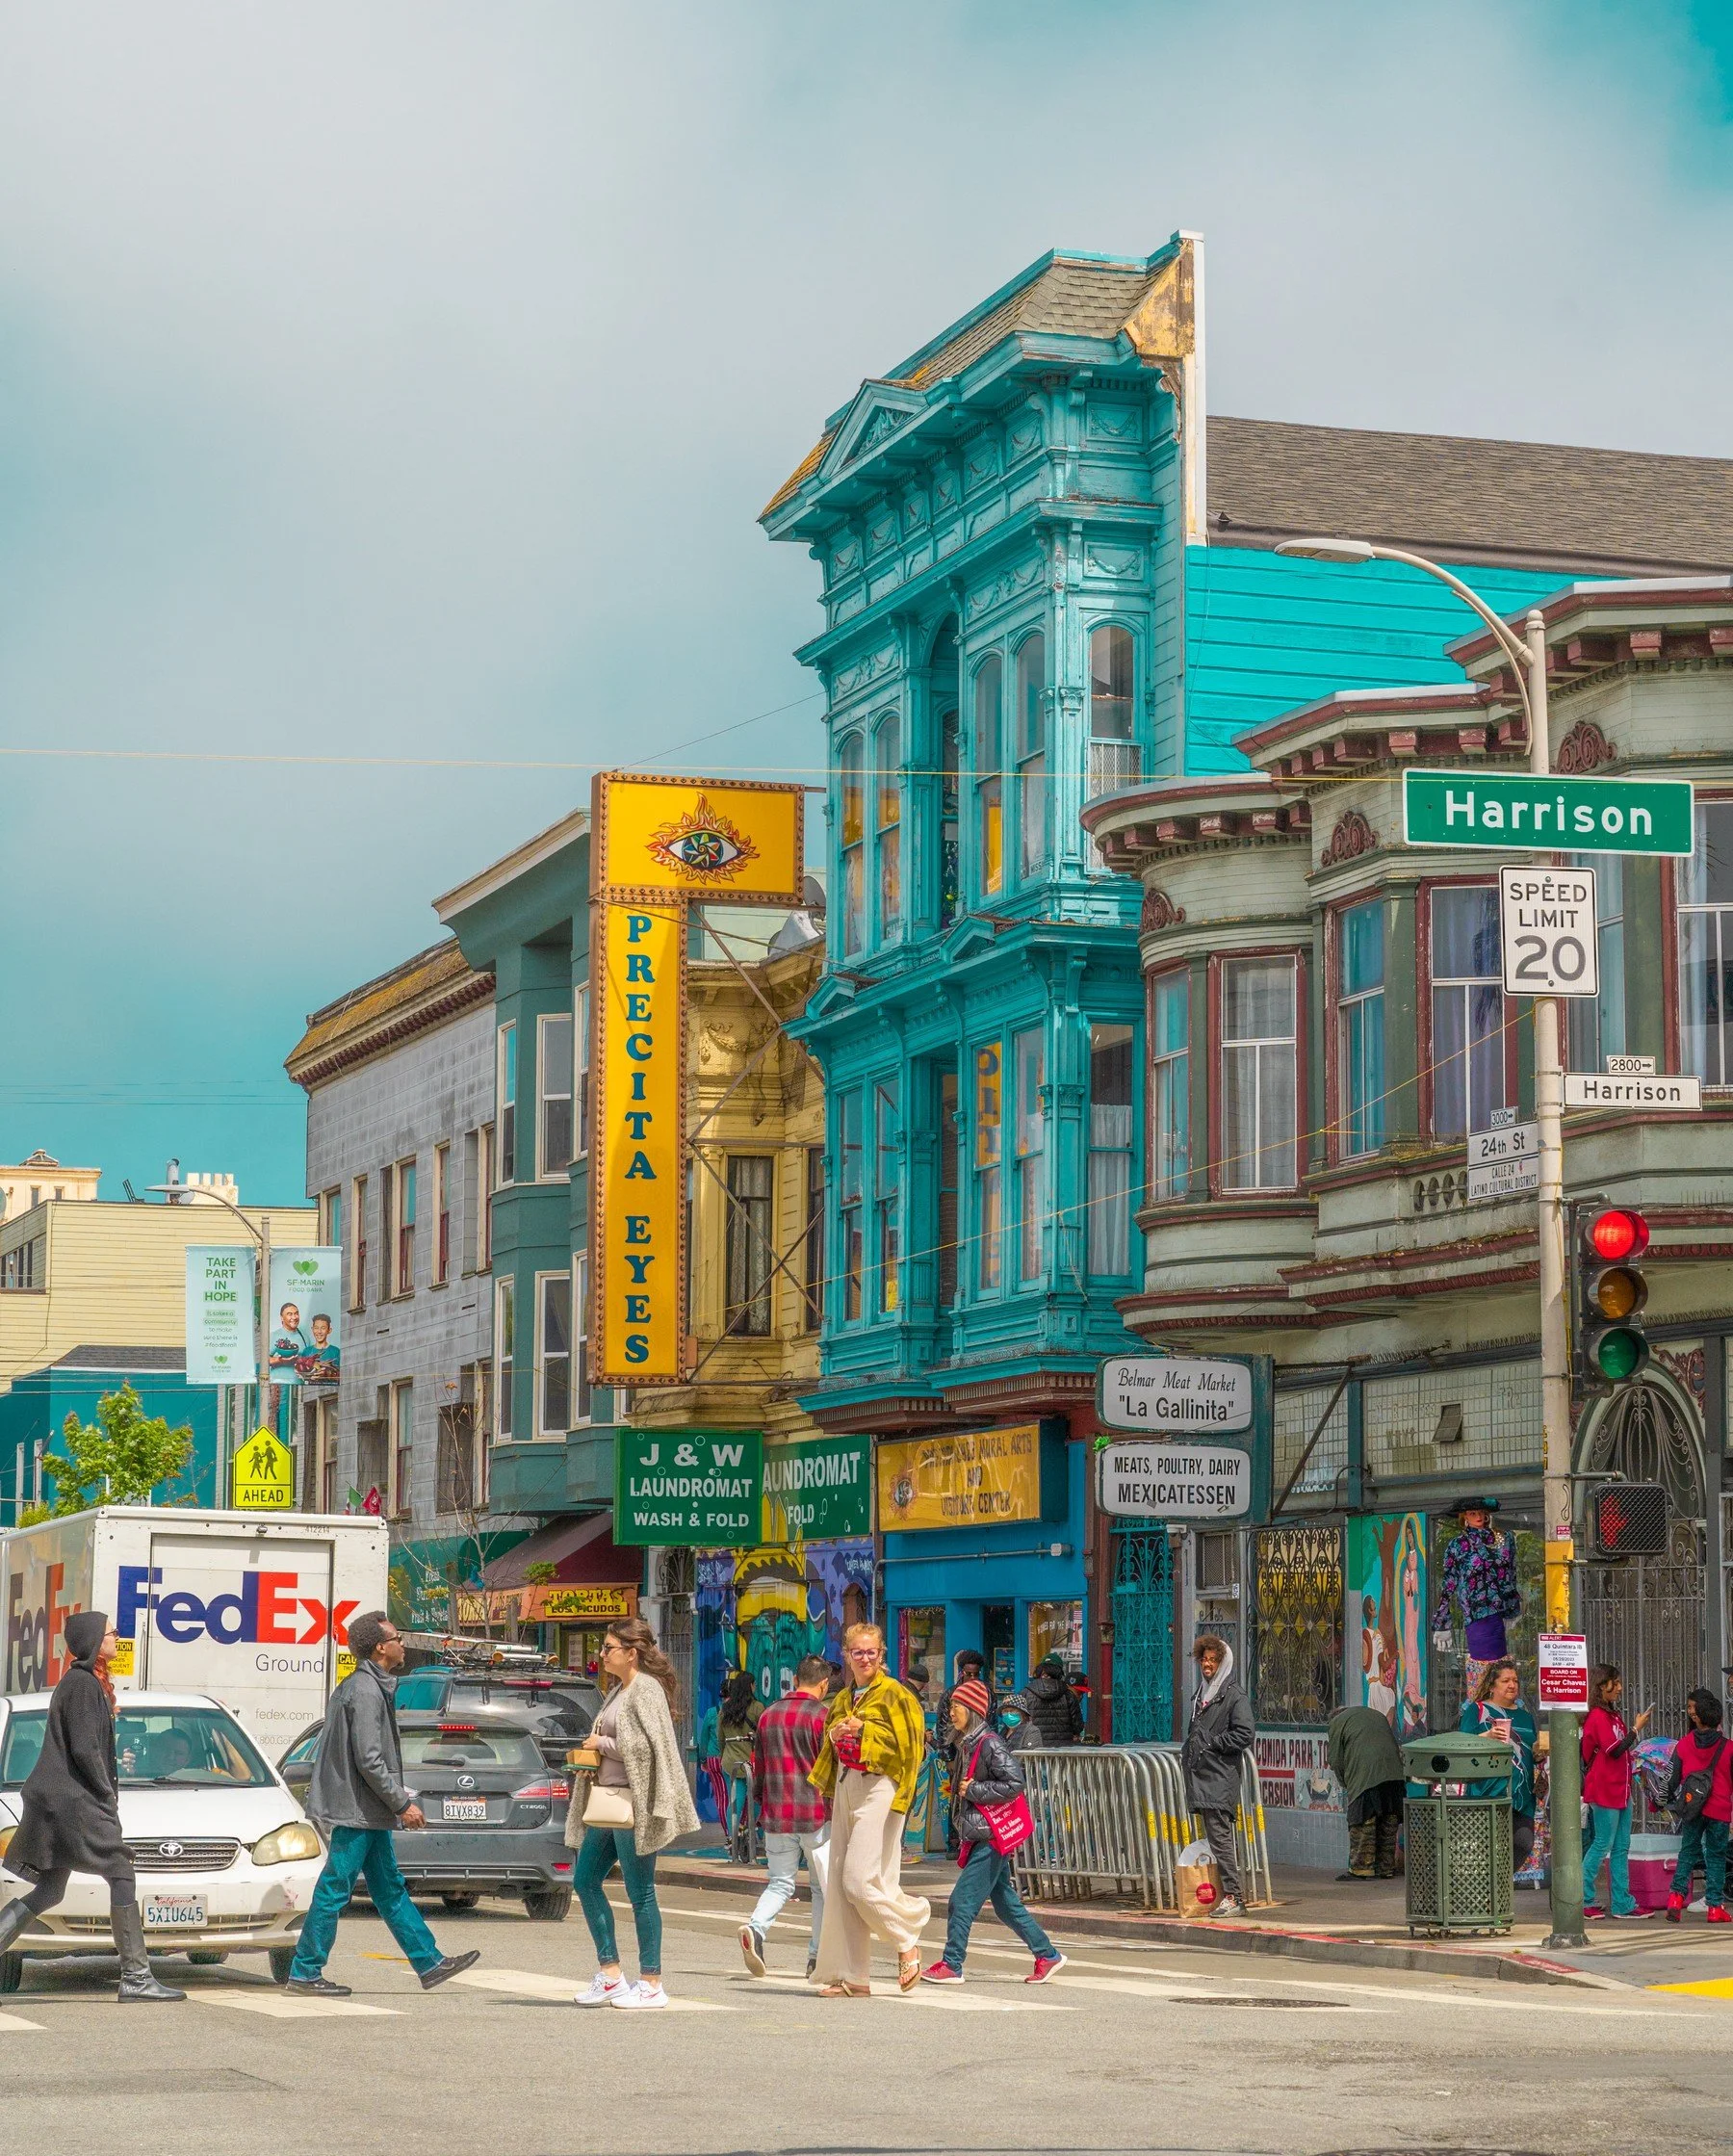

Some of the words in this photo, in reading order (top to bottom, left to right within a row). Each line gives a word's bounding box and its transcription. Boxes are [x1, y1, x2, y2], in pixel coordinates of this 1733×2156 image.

[1446, 791, 1652, 836] Harrison
[1510, 883, 1587, 902] SPEED
[1519, 909, 1578, 927] LIMIT
[1514, 935, 1586, 981] 20
[625, 916, 657, 1180] PRECITA
[1612, 1059, 1641, 1071] 2800
[1584, 1080, 1681, 1101] Harrison
[1492, 1111, 1508, 1126] 3000
[1482, 1137, 1506, 1157] 24th
[1513, 1131, 1524, 1151] St
[1492, 1165, 1506, 1179] CALLE
[1509, 1164, 1514, 1176] 24
[1471, 1183, 1487, 1197] LATINO
[1489, 1178, 1513, 1194] CULTURAL
[1515, 1174, 1537, 1188] DISTRICT
[207, 1258, 236, 1266] TAKE
[205, 1269, 236, 1279] PART
[215, 1281, 226, 1289] IN
[625, 1215, 655, 1364] EYES
[205, 1291, 237, 1301] HOPE
[1118, 1368, 1155, 1387] Belmar
[1163, 1371, 1191, 1389] Meat
[1198, 1373, 1235, 1391] Market
[1120, 1395, 1148, 1416] "La
[1156, 1397, 1234, 1420] Gallinita"
[639, 1443, 660, 1466] J
[674, 1443, 700, 1466] &
[711, 1444, 744, 1467] W
[763, 1452, 861, 1493] AUNDROMAT
[1115, 1457, 1152, 1475] MEATS,
[1158, 1458, 1203, 1476] POULTRY,
[1209, 1459, 1240, 1476] DAIRY
[244, 1490, 284, 1502] AHEAD
[630, 1477, 753, 1498] LAUNDROMAT
[1119, 1484, 1235, 1504] MEXICATESSEN
[634, 1512, 683, 1526] WASH
[689, 1513, 700, 1526] &
[707, 1513, 749, 1527] FOLD
[788, 1504, 815, 1524] FOLD
[116, 1566, 360, 1645] FedEx
[549, 1589, 624, 1605] TORTAS
[116, 1642, 132, 1651] TION
[255, 1653, 324, 1674] Ground
[255, 1708, 314, 1721] fedex.com
[1255, 1737, 1287, 1768] COMIDA
[1289, 1739, 1313, 1769] PARA
[1317, 1740, 1330, 1770] TO
[1259, 1780, 1295, 1807] CASION
[148, 1907, 203, 1922] 5XIU645
